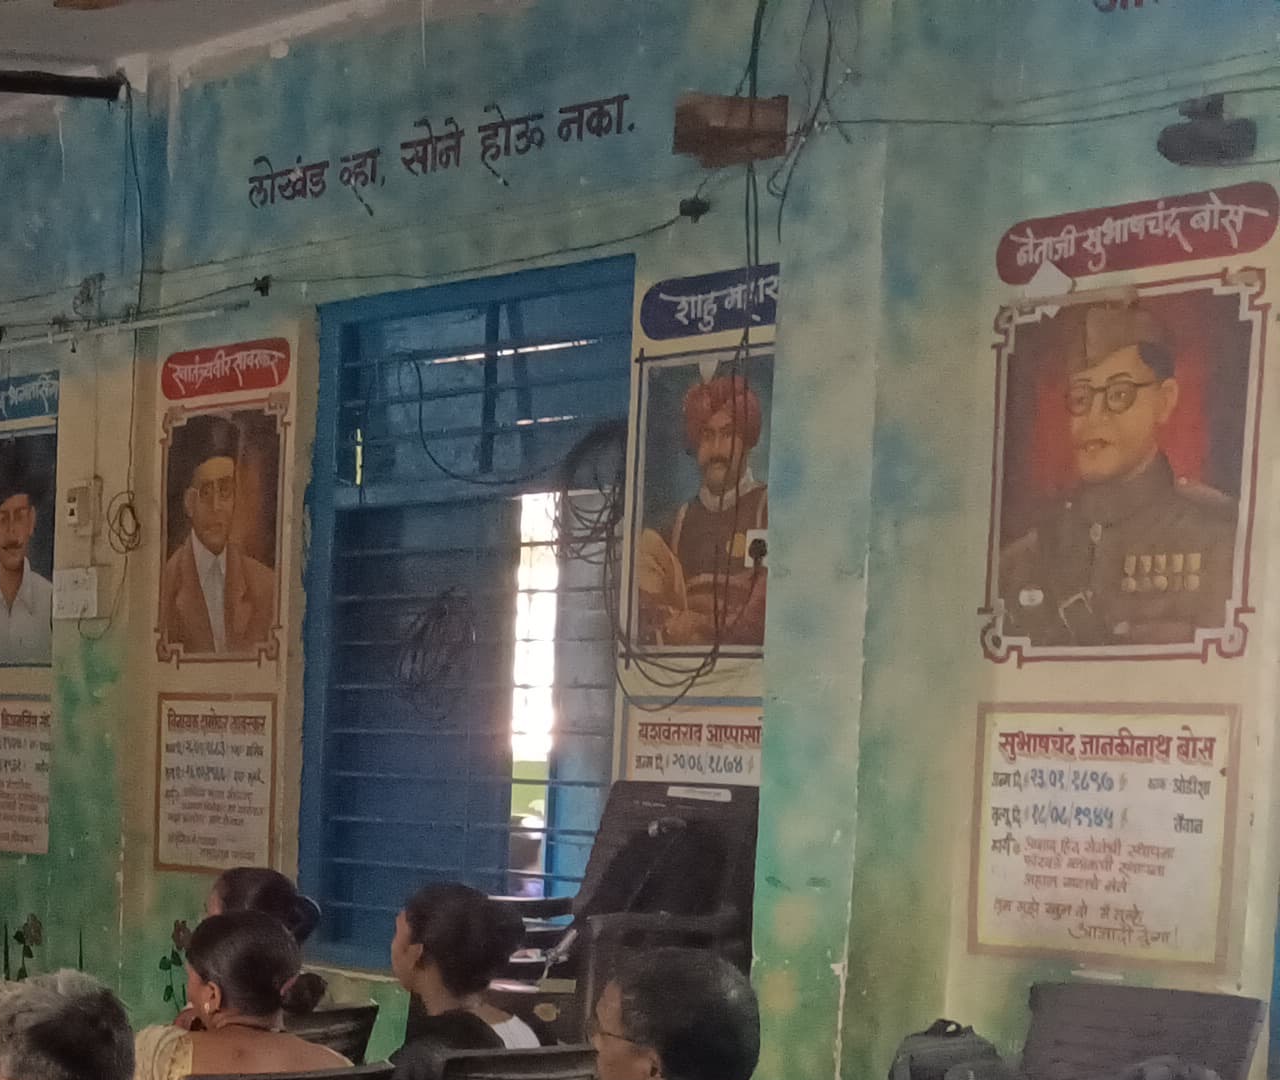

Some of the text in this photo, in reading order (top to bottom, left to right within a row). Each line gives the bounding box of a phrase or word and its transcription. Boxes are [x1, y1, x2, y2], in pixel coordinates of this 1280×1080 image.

[248, 156, 329, 208] लोखंड
[400, 118, 466, 176] सोने
[478, 103, 546, 187] होऊ
[1009, 225, 1077, 266] नेताजी
[1189, 192, 1269, 249] बोस
[638, 717, 762, 745] यशवंतराव आप्पासा
[1078, 727, 1173, 761] जानकीनाथ
[1177, 725, 1216, 761] बोस
